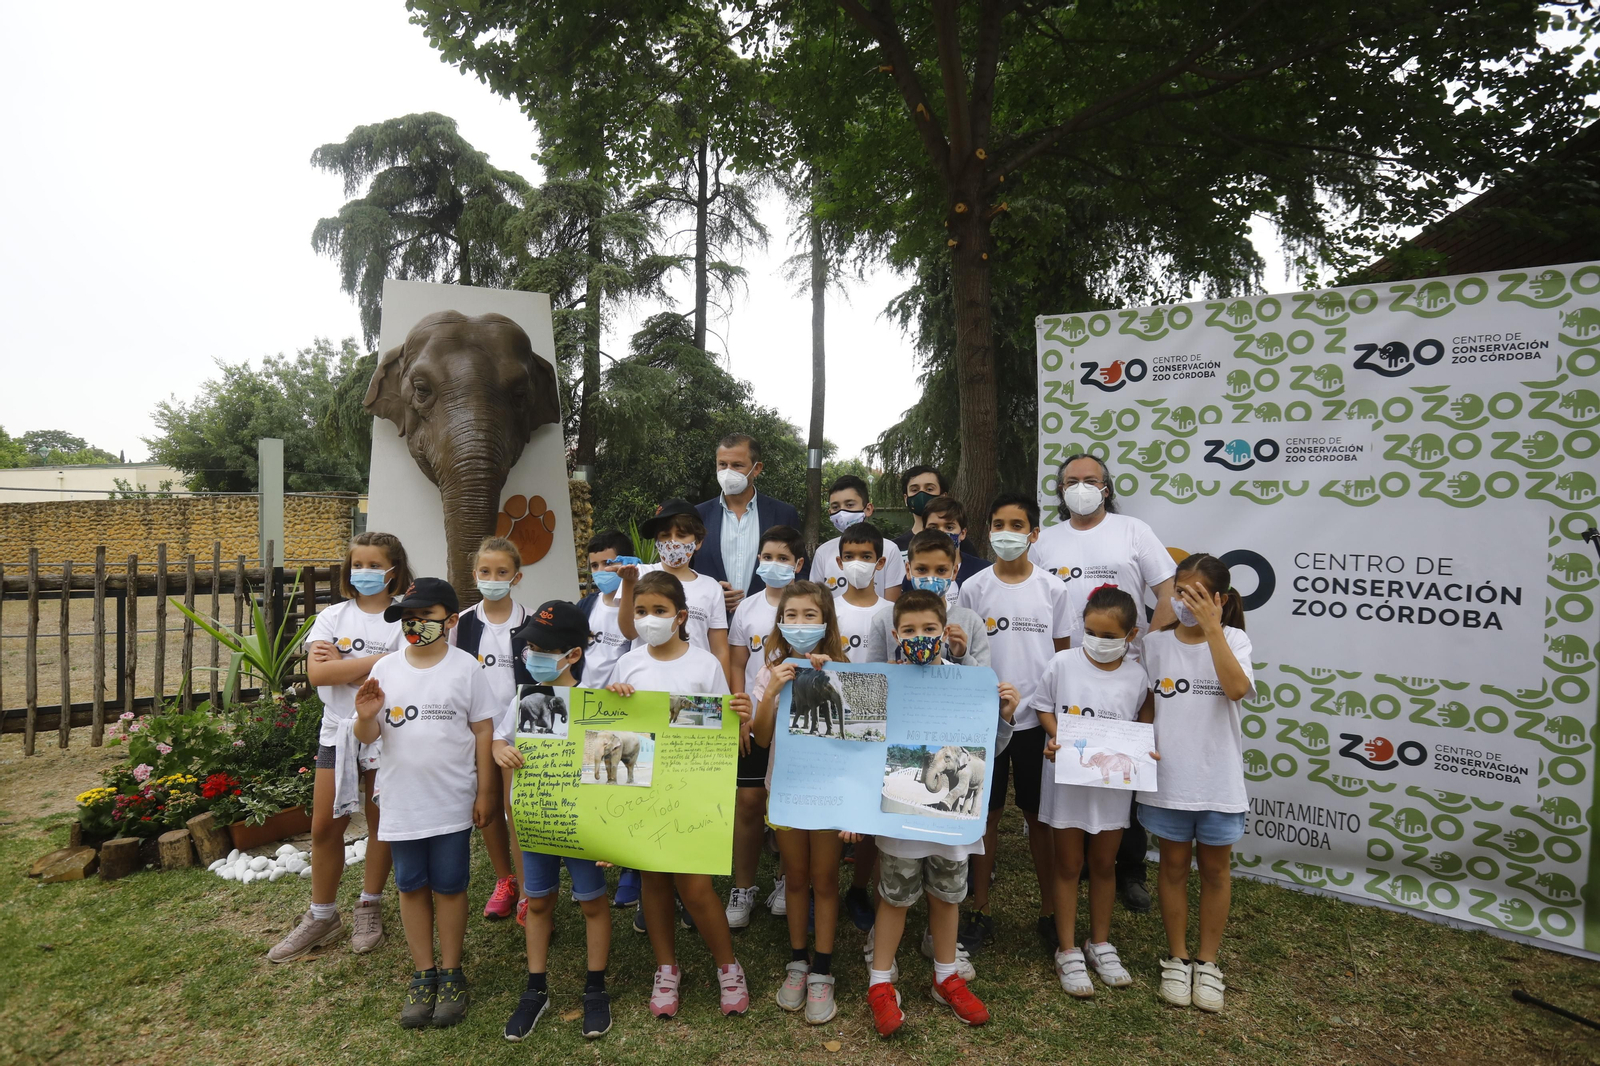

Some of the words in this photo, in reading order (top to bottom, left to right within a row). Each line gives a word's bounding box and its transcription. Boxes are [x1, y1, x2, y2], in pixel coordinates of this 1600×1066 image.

[1452, 333, 1502, 345] CENTRO
[1505, 332, 1522, 341] DE
[1452, 340, 1549, 354] CONSERVACIÓN
[1152, 355, 1188, 364] CENTRO
[1190, 353, 1202, 362] DE
[1451, 355, 1477, 364] ZOO
[1479, 351, 1542, 362] CÓRDOBA
[1152, 360, 1221, 372] CONSERVACIÓN
[1152, 373, 1172, 381] ZOO
[1173, 369, 1216, 380] CÓRDOBA
[1285, 437, 1325, 446] CENTRO
[1328, 436, 1342, 445] DE
[1285, 444, 1364, 454] CONSERVACIÓN
[1285, 454, 1306, 462] ZOO
[1308, 451, 1358, 462] CÓRDOBA
[1294, 552, 1405, 574] CENTRO
[1416, 556, 1454, 576] DE
[1292, 575, 1522, 606] CONSERVACIÓN
[1292, 598, 1348, 618] ZOO
[1355, 599, 1504, 631] CÓRDOBA
[921, 666, 963, 680] FLAVIA
[582, 690, 629, 720] Flavia
[906, 729, 921, 741] NO
[923, 730, 938, 742] TE
[1435, 744, 1483, 759] CENTRO
[1485, 752, 1502, 762] DE
[1434, 753, 1529, 776] CONSERVACIÓN
[1434, 762, 1459, 773] ZOO
[1461, 765, 1521, 785] CÓRDOBA
[777, 792, 791, 804] TE
